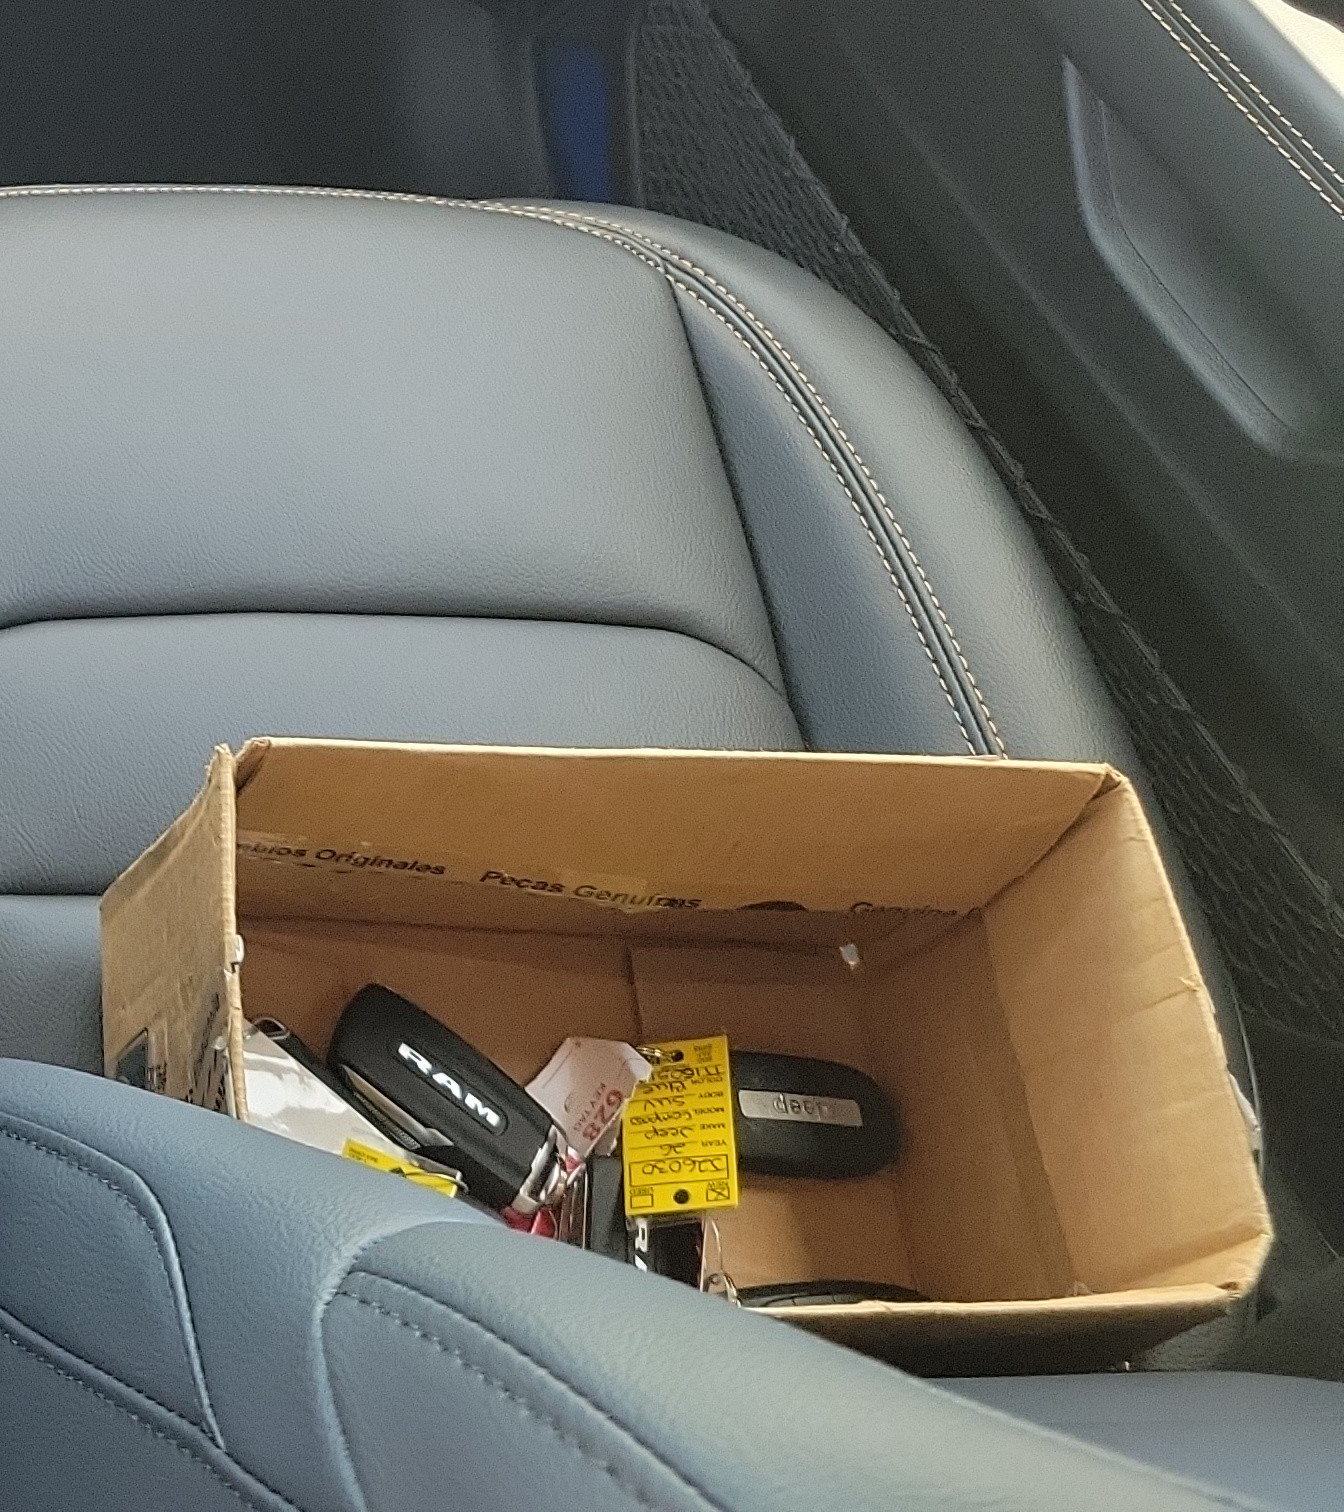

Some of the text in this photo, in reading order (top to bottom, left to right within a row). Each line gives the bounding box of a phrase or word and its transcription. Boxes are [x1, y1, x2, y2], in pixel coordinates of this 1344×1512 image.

[314, 849, 446, 875] Originales
[398, 1042, 502, 1127] RAM
[694, 1106, 725, 1115] MODEL
[644, 1126, 694, 1140] Jeep
[702, 1139, 726, 1147] YEAR
